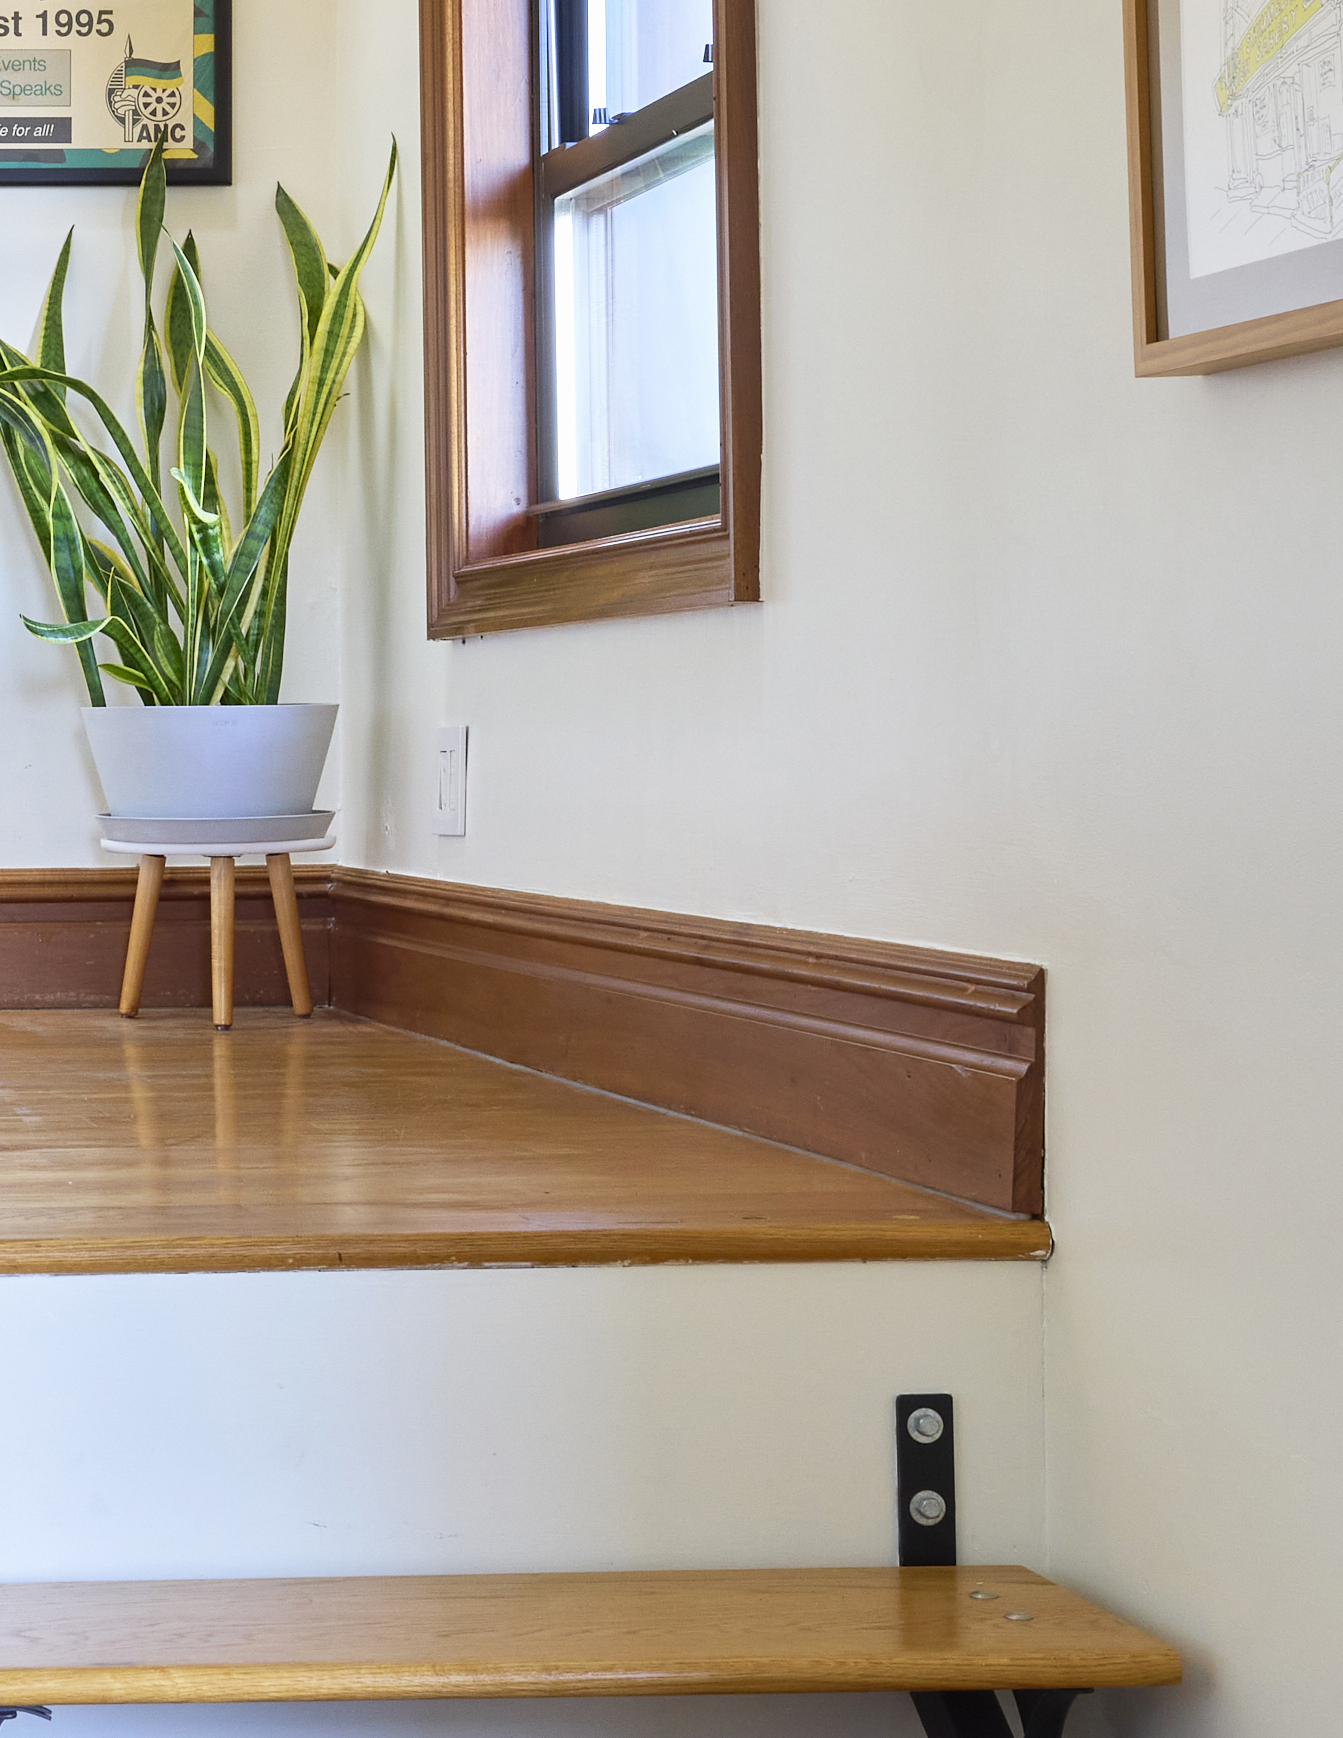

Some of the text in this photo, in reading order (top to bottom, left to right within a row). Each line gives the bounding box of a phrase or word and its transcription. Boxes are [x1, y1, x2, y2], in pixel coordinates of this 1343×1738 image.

[35, 9, 114, 36] 1995
[0, 80, 63, 100] Speaks
[12, 124, 30, 137] for
[33, 124, 54, 137] all!
[137, 123, 185, 143] ANC
